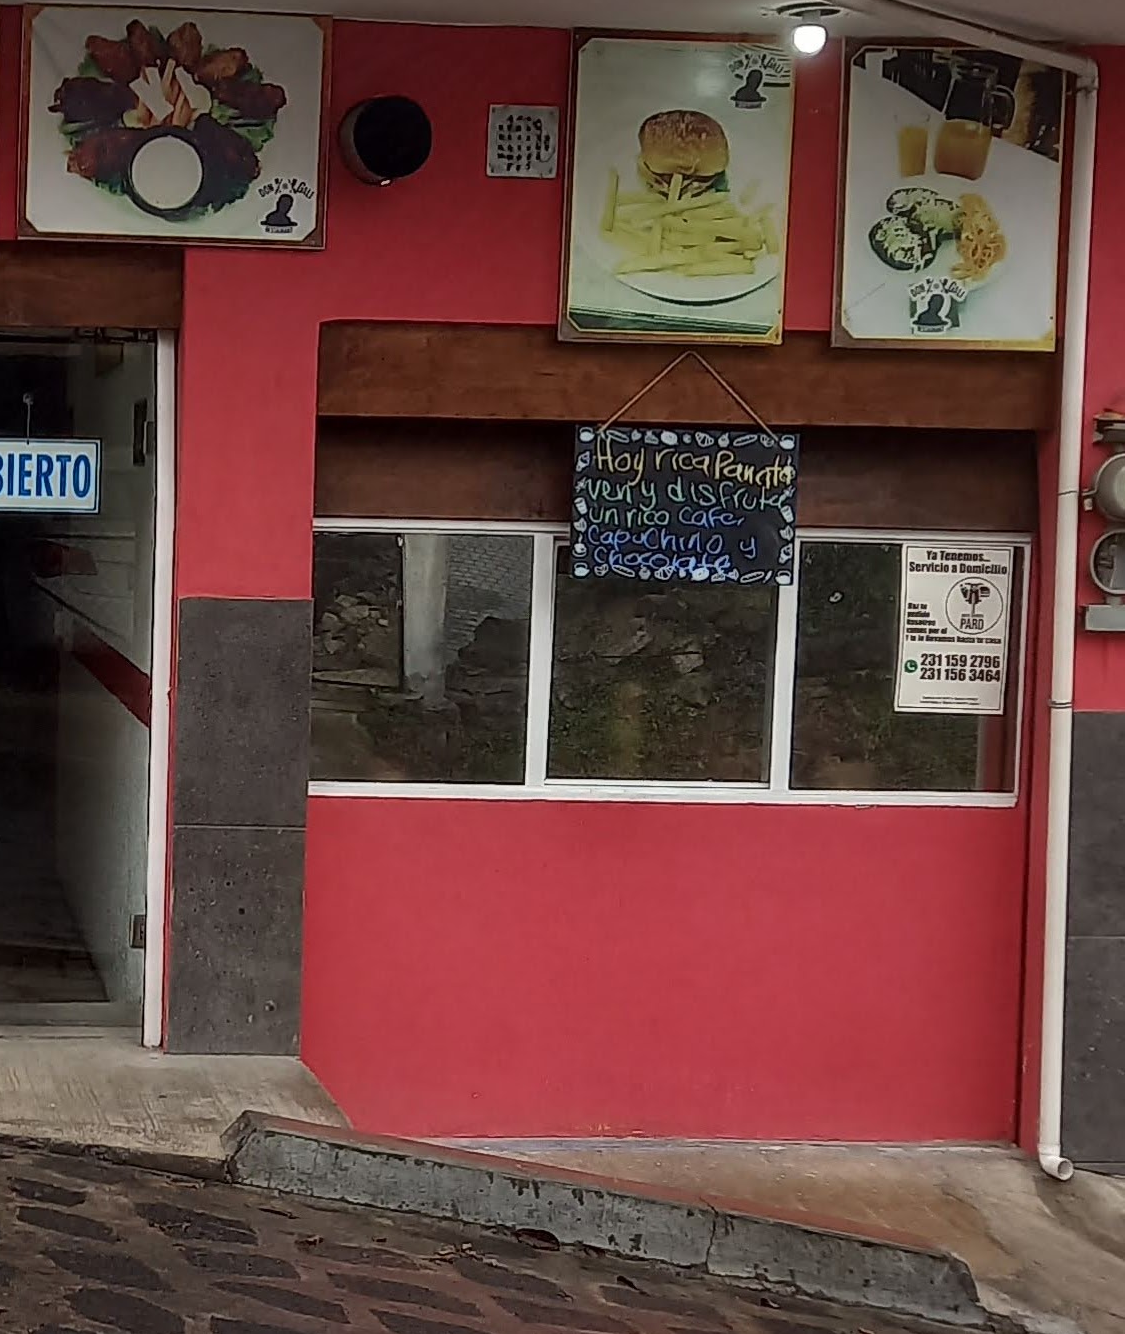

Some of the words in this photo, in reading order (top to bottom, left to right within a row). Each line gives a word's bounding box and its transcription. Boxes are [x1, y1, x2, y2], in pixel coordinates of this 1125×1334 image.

[595, 432, 645, 486] Hoy
[655, 448, 710, 478] rica
[585, 478, 633, 504] ven
[639, 479, 656, 511] y
[588, 506, 618, 525] un
[627, 509, 670, 529] rico
[739, 537, 757, 559] y
[926, 550, 938, 561] Ya
[909, 561, 950, 573] Servicio
[951, 564, 958, 573] a
[959, 563, 1008, 575] Domicilio
[920, 653, 943, 666] 231
[944, 654, 968, 668] 159
[969, 655, 1001, 669] 2796
[919, 667, 942, 680] 231
[944, 668, 967, 682] 156
[968, 669, 1001, 683] 3464
